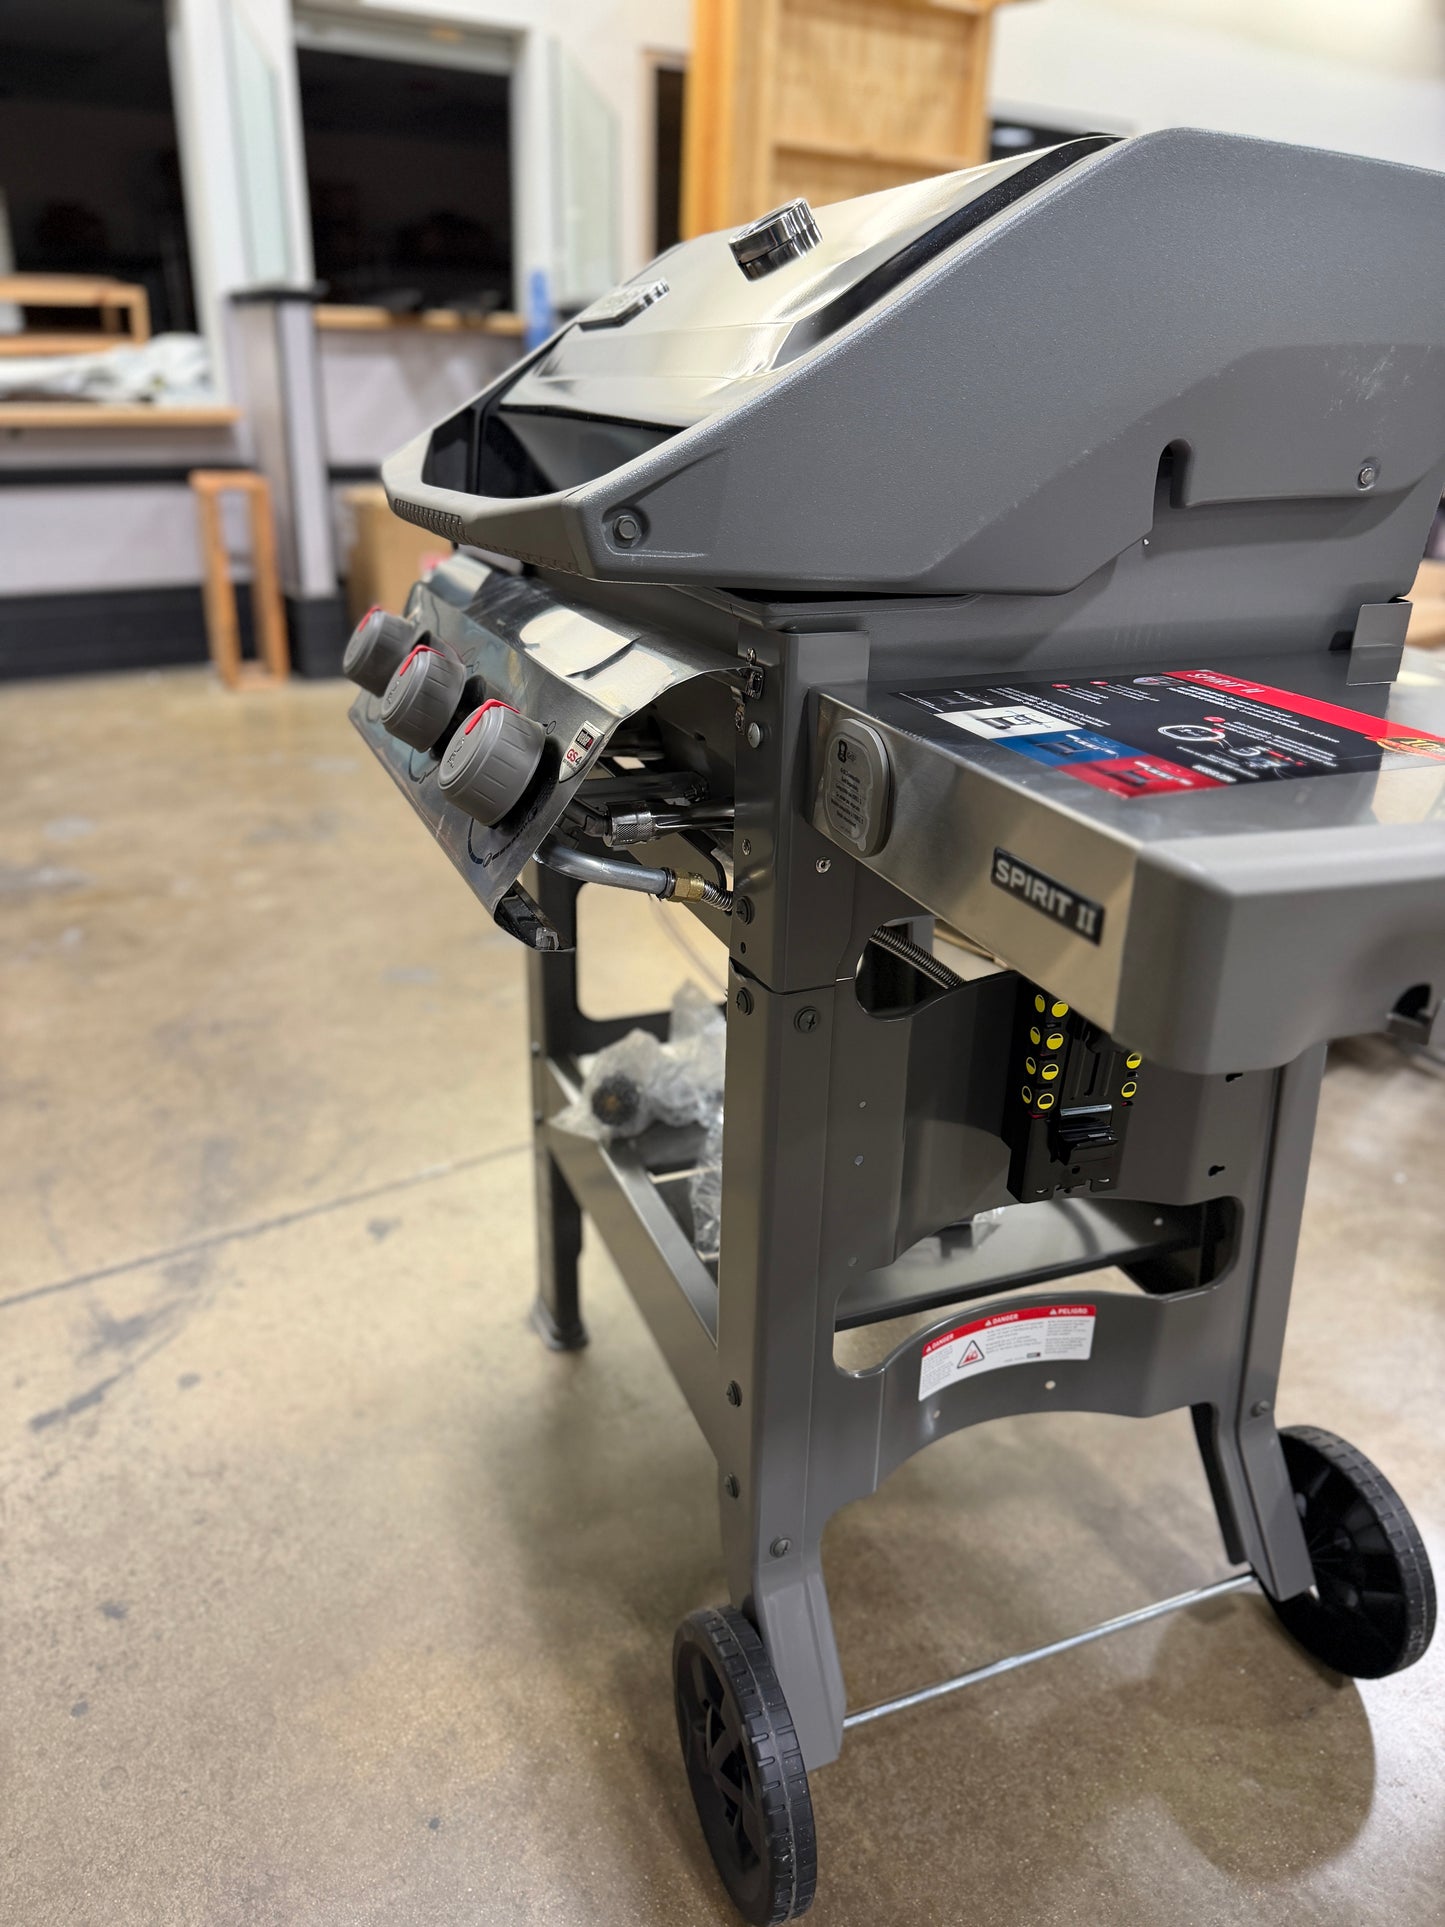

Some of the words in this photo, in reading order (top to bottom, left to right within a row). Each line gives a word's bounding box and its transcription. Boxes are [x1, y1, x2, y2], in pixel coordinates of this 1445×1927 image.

[1186, 673, 1248, 688] SPIRIT
[566, 748, 582, 765] GS4
[995, 859, 1073, 918] SPIRIT
[1075, 903, 1097, 936] II
[992, 1313, 1019, 1325] DANGER
[1058, 1307, 1088, 1315] PELIGRO
[931, 1333, 954, 1350] DANGER
